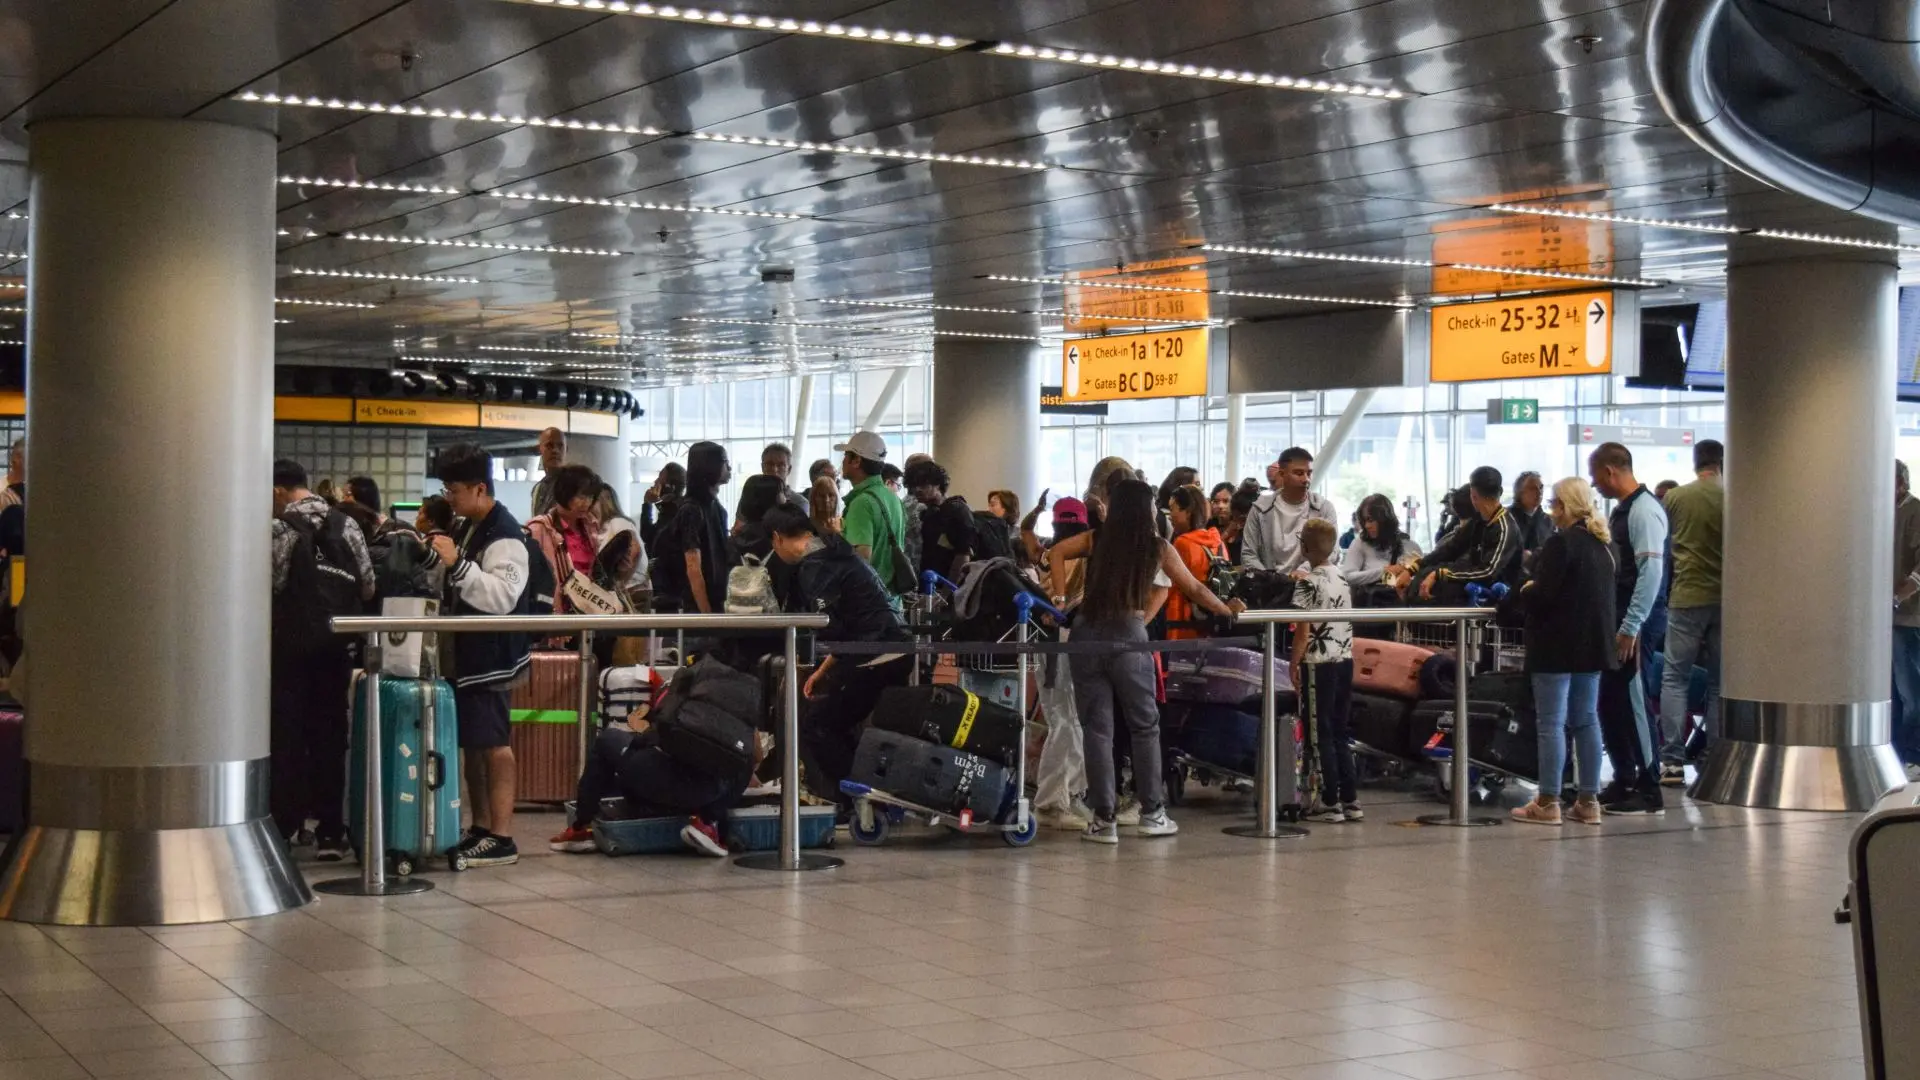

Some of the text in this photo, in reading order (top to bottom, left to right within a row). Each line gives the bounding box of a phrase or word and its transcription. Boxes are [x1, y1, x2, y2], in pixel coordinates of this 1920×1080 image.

[1448, 304, 1560, 332] Check-in 25-32
[1095, 337, 1183, 360] Check-in 1a 1-20
[1502, 343, 1559, 368] Gates M
[1095, 378, 1117, 390] Gates
[377, 405, 417, 417] Check-in
